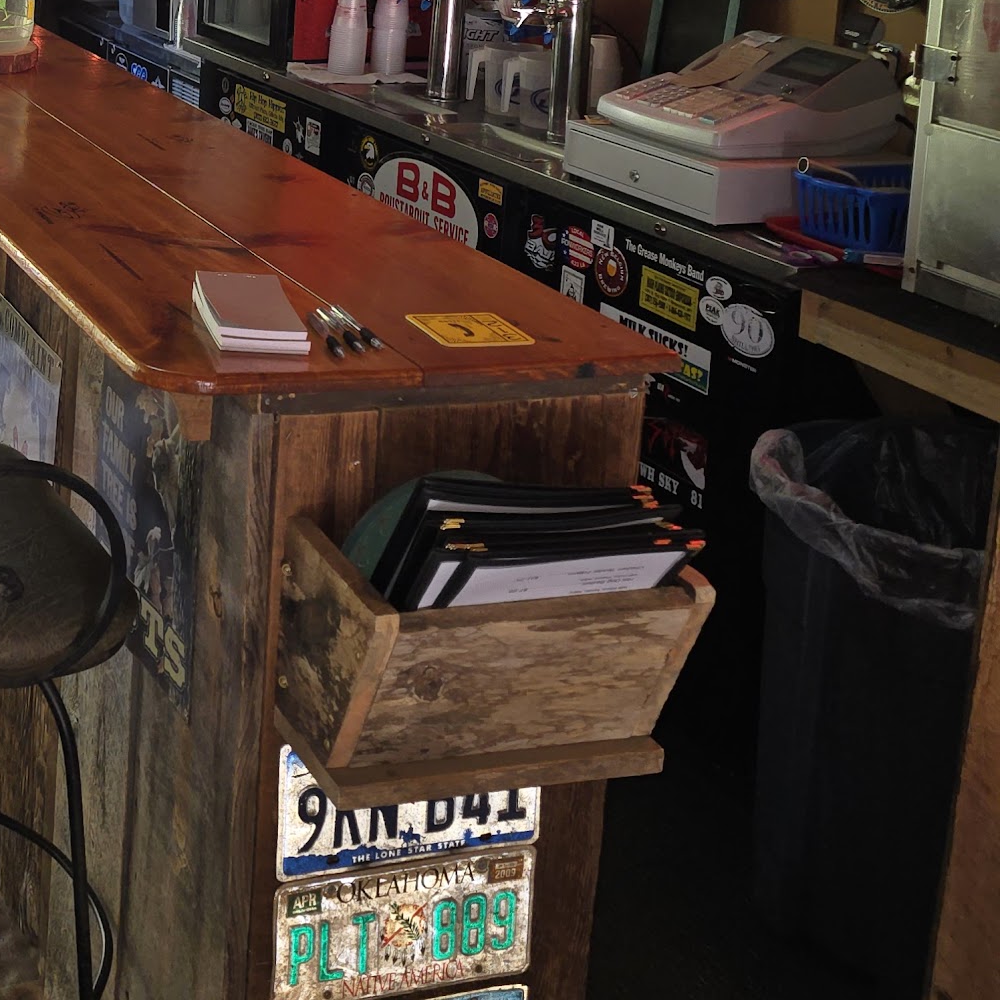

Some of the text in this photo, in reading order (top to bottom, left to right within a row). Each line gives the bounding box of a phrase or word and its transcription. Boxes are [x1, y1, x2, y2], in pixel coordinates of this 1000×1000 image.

[433, 216, 469, 245] SERVICE
[625, 238, 705, 282] The Grease Monkeys Band
[731, 311, 763, 344] 90
[105, 385, 125, 433] OUR
[102, 419, 137, 487] FAMILY
[101, 460, 122, 520] TREE
[690, 490, 702, 509] 81
[352, 838, 466, 864] THE LONE STAR STATE
[336, 862, 476, 904] OKLAHOMA
[494, 867, 516, 880] 2009
[292, 895, 317, 910] APR
[289, 912, 376, 987] PLT
[342, 959, 465, 999] NATIVE AMERICA
